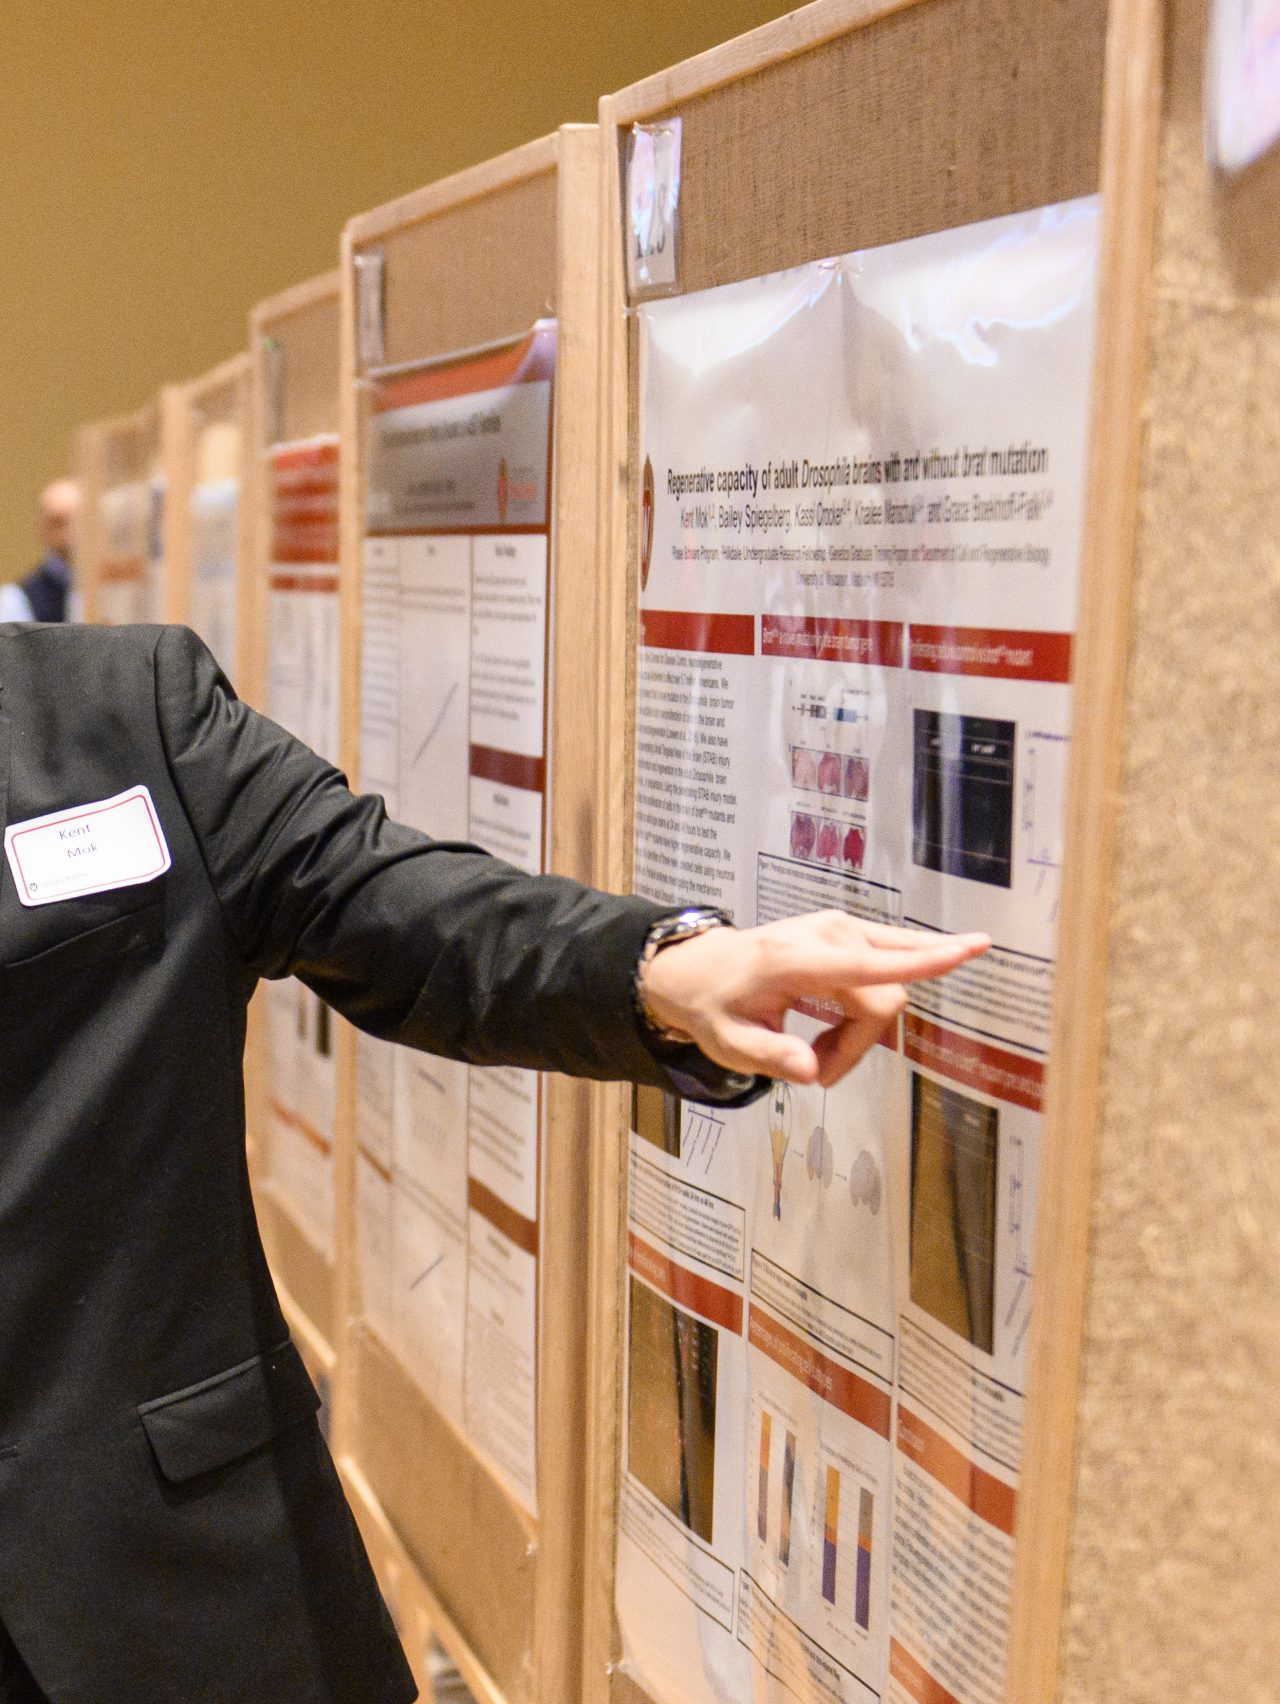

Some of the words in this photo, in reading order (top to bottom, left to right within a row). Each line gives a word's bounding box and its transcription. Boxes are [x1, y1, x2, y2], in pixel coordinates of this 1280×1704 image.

[668, 464, 715, 500] Regenerative
[717, 462, 758, 498] capacity
[762, 460, 771, 490] of
[774, 459, 798, 489] adult
[802, 455, 850, 495] Drosophila
[853, 454, 882, 485] brains
[904, 449, 920, 482] and
[923, 446, 960, 480] without
[991, 439, 1049, 476] mutation
[719, 504, 742, 533] Bailey
[58, 824, 93, 841] Kent
[67, 843, 100, 858] Mok
